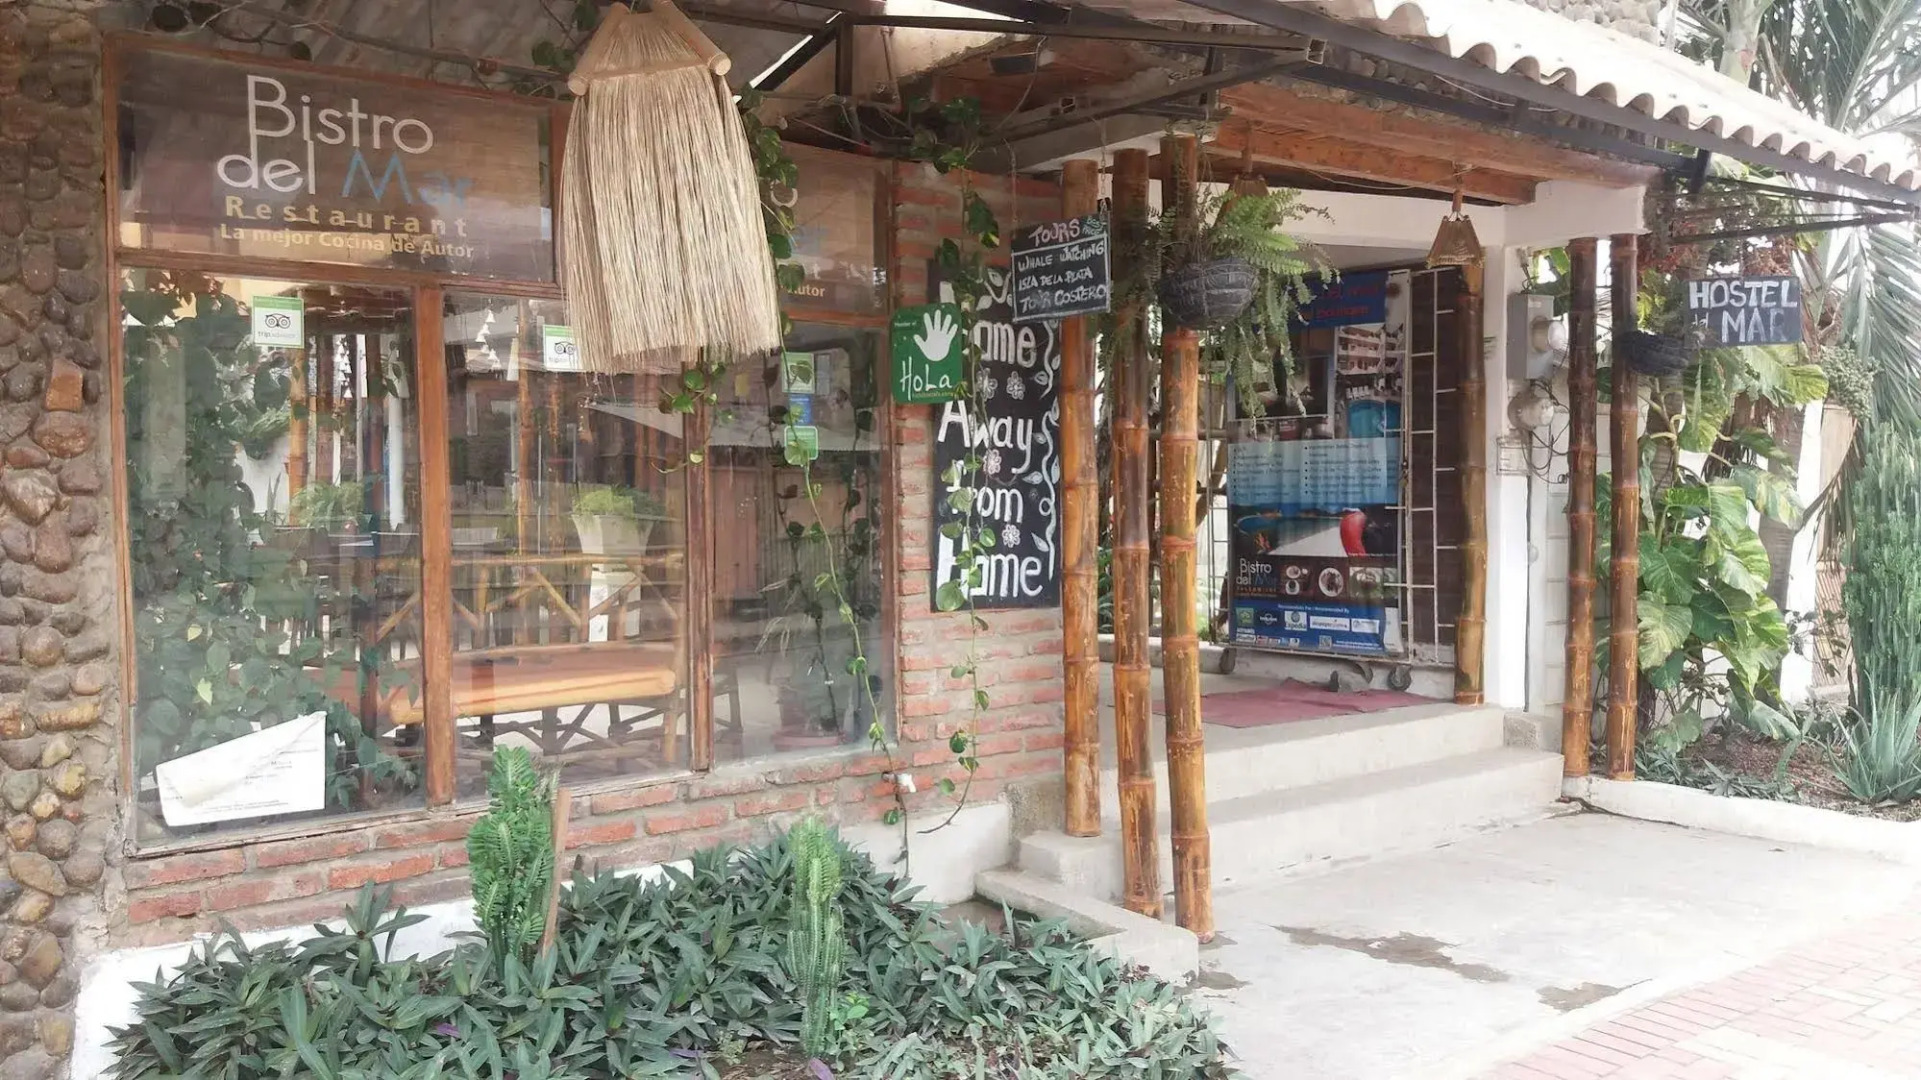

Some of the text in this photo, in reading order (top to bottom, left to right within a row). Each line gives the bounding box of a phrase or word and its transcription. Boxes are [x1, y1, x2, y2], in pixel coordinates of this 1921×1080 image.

[247, 74, 434, 154] Bistro
[217, 139, 473, 208] del Mar
[225, 196, 467, 237] Restaurant
[220, 224, 474, 258] La mejor Cocina de Autor
[1028, 219, 1080, 247] TOURS
[1018, 240, 1105, 271] WHALE WATCHING
[788, 283, 826, 297] utor
[1018, 275, 1039, 291] ISLA
[1054, 284, 1107, 306] COSTERO
[1689, 280, 1798, 309] HOSTEL
[1721, 307, 1788, 343] MAR
[937, 400, 1034, 474] Away
[1239, 558, 1272, 574] Bistro
